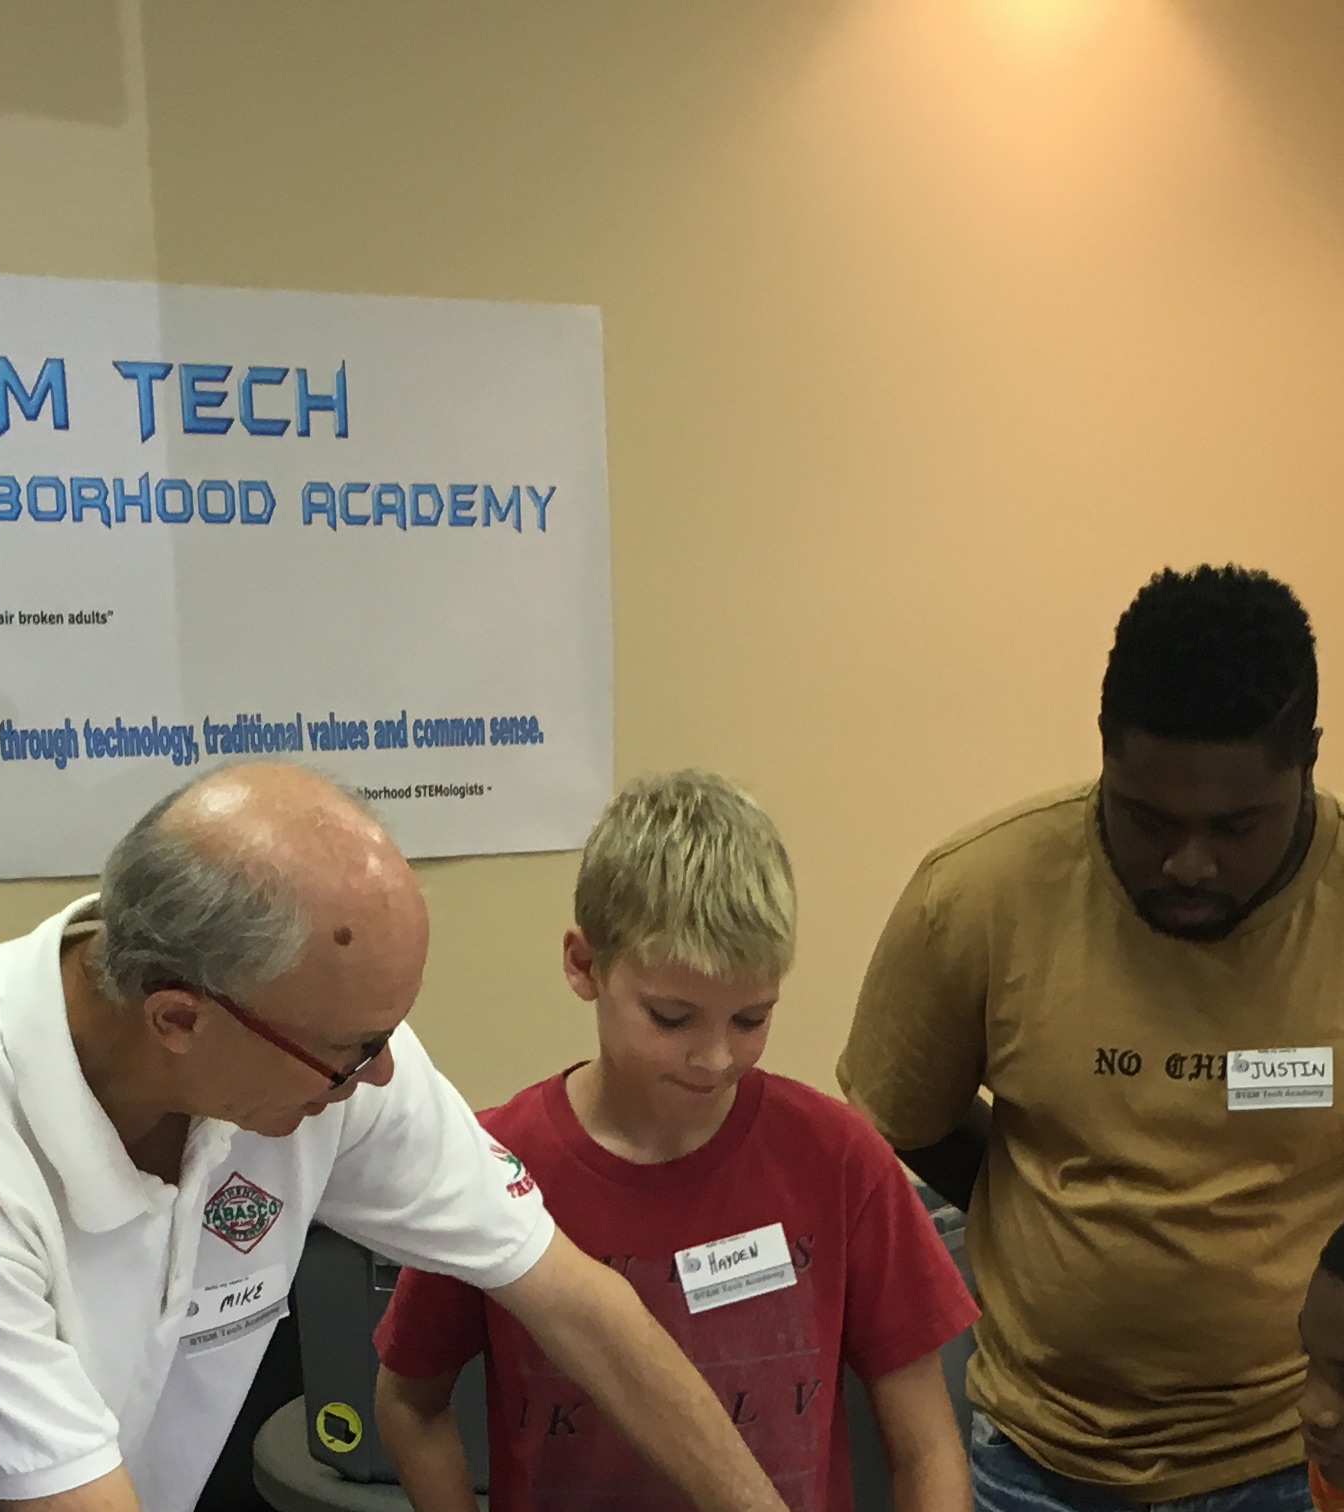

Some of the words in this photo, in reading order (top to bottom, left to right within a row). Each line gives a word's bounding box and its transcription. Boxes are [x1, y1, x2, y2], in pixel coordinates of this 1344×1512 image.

[112, 359, 350, 443] TECH
[301, 479, 558, 533] ACADEMY
[18, 611, 64, 626] broken
[83, 716, 199, 766] technology,
[203, 712, 304, 756] traditional
[307, 711, 369, 752] values
[374, 709, 408, 750] and
[413, 717, 485, 748] common
[489, 713, 543, 746] sense.
[415, 782, 484, 799] STEMologists
[1094, 1048, 1143, 1077] NO
[1250, 1058, 1325, 1083] JUSTIN
[204, 1201, 277, 1223] TABASCO
[707, 1242, 761, 1273] HAYDEN
[220, 1281, 263, 1312] MIKE
